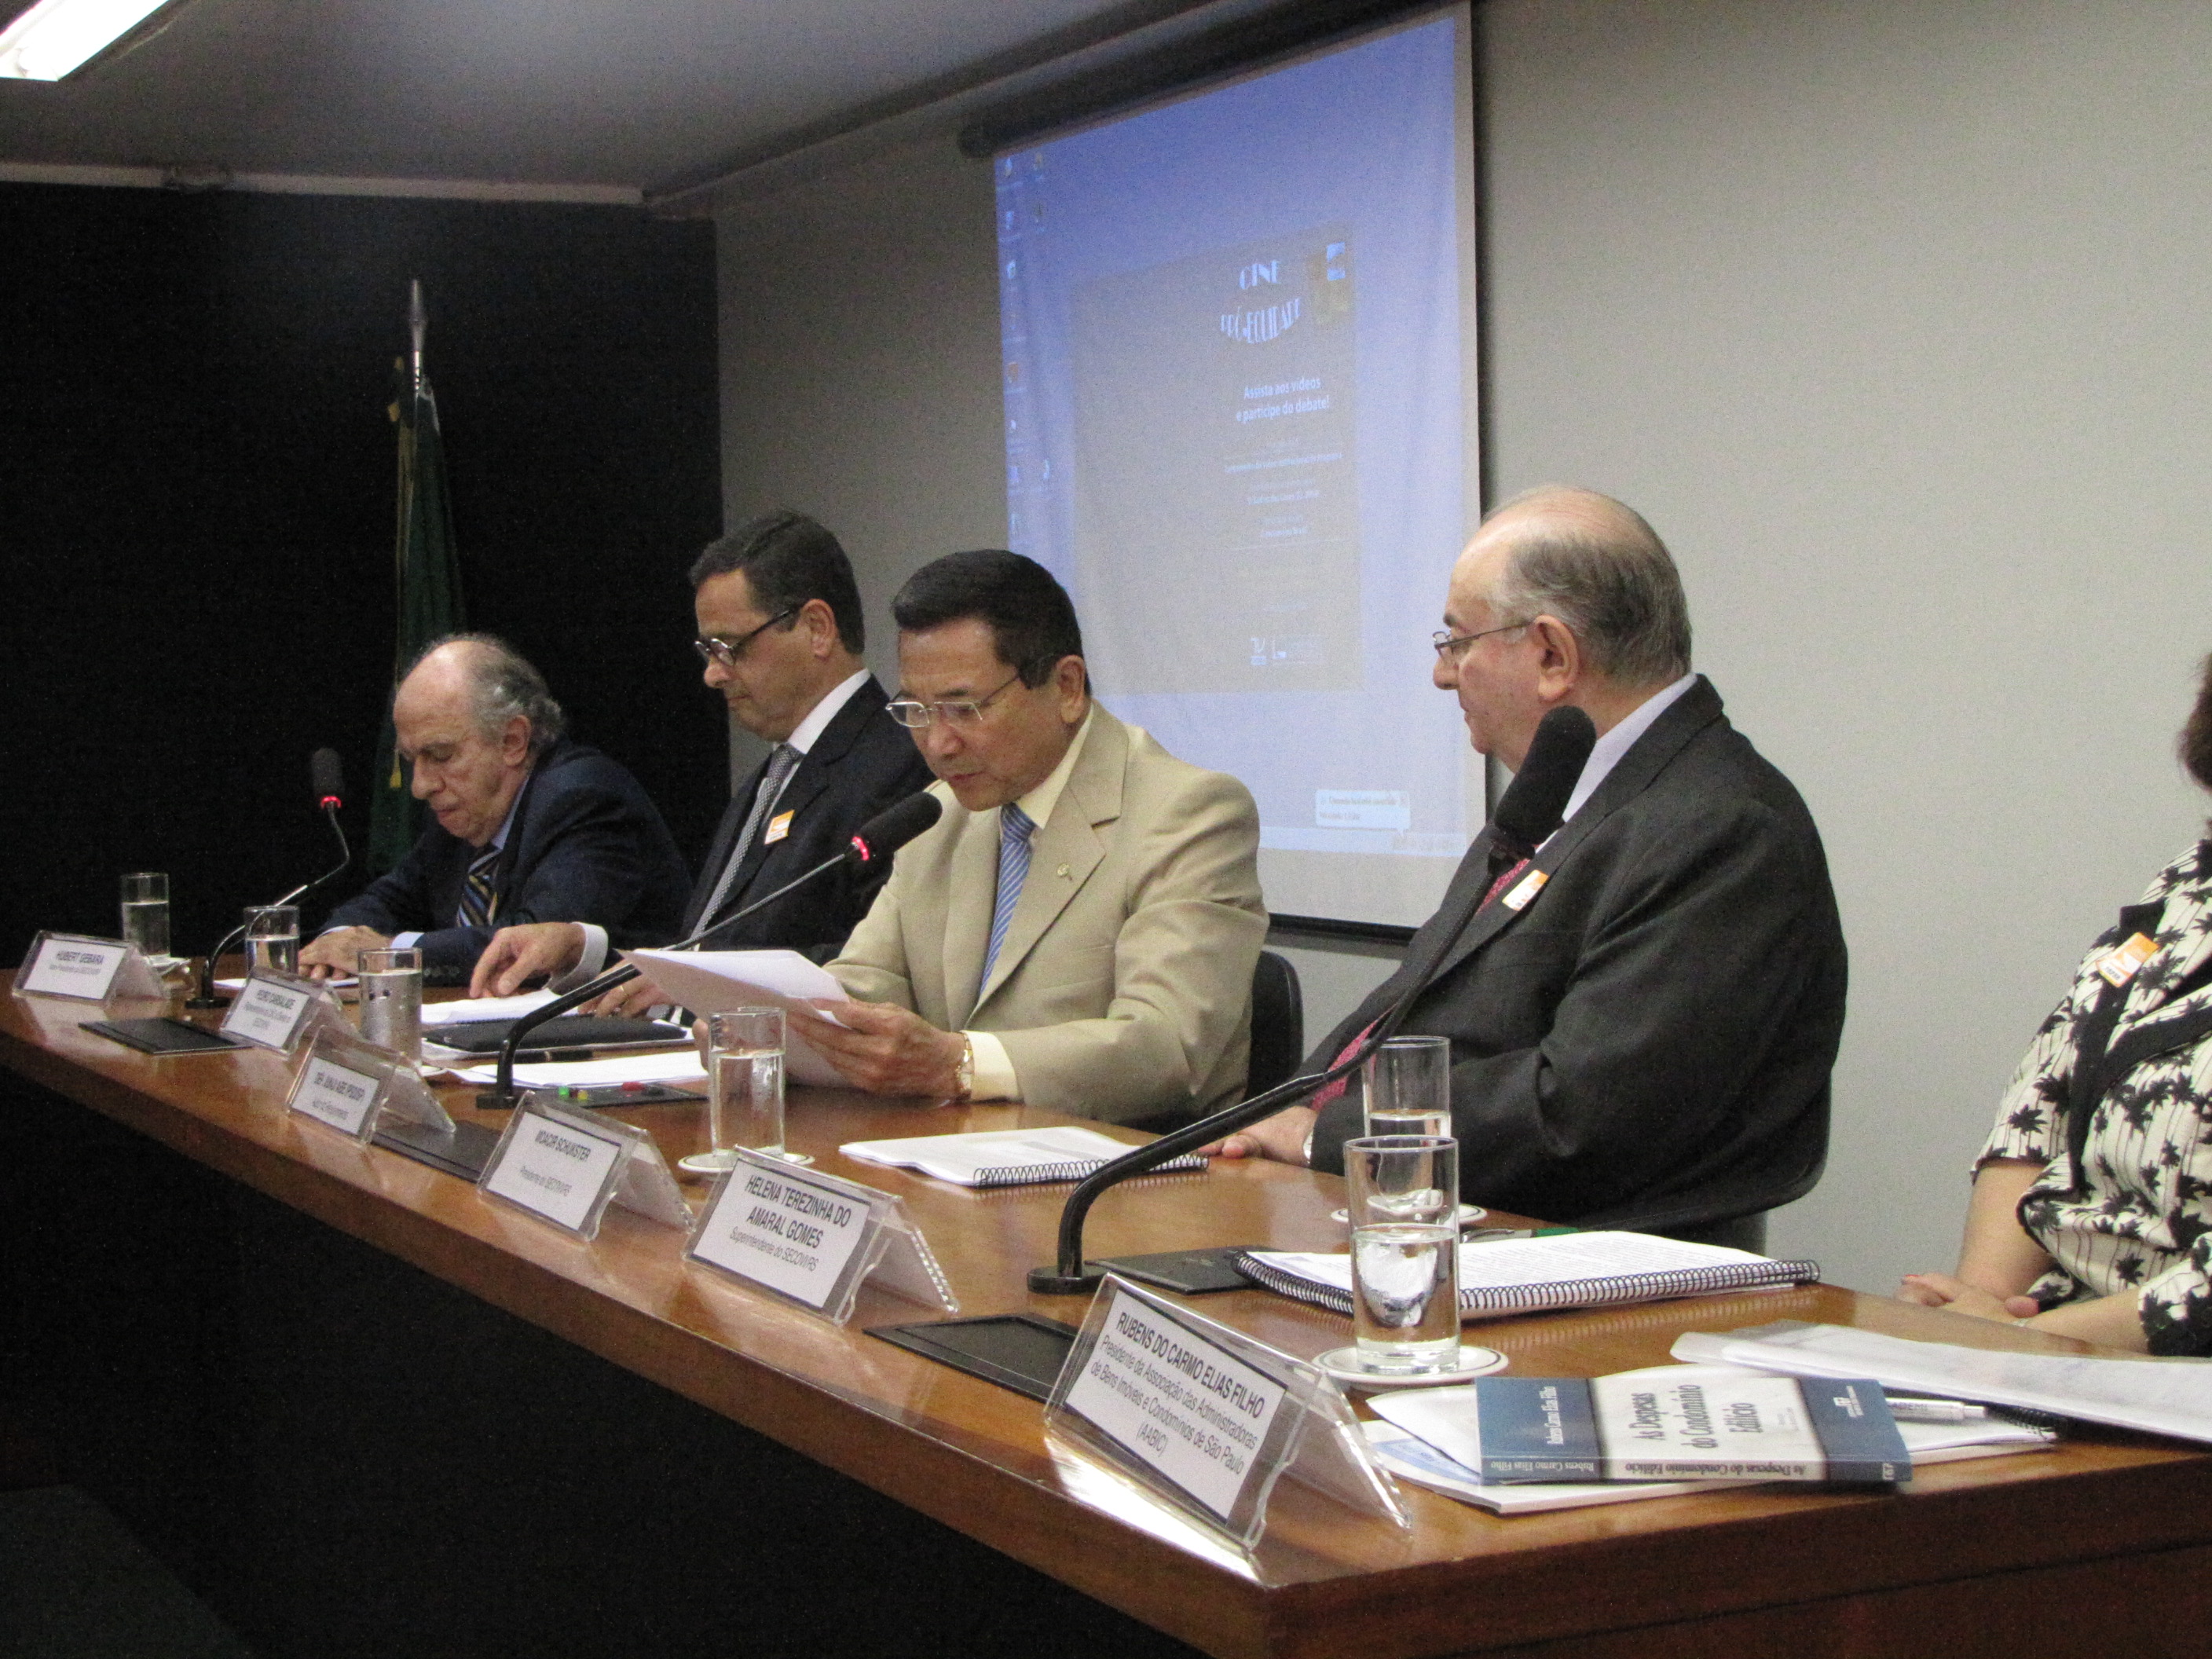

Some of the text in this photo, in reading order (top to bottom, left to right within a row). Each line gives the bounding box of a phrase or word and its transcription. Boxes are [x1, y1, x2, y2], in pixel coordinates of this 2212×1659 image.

[1242, 405, 1281, 424] participe
[1281, 400, 1295, 415] do
[745, 1174, 852, 1228] HELENA TEREZINHA DO
[746, 1206, 824, 1248] AMARAL GOMES
[773, 1243, 783, 1258] do
[1115, 1311, 1265, 1419] RUBENS DO CARMO ELIAS FILHO
[1100, 1335, 1258, 1451] Presidente da Associação das Administradoras
[1090, 1359, 1101, 1377] de
[1100, 1364, 1119, 1389] Bens
[1115, 1375, 1144, 1407] Imóveis
[1148, 1397, 1195, 1441] Condomínios
[1193, 1429, 1206, 1448] de
[1204, 1434, 1222, 1459] São
[1219, 1445, 1245, 1475] Paulo
[1628, 1392, 1670, 1441] As Despesas
[1668, 1384, 1719, 1448] do Condomínio
[1135, 1419, 1169, 1458] (AABIC)
[1491, 1460, 1595, 1471] Rubens Carmo Elias Filho
[1664, 1463, 1727, 1475] Condomínio
[1730, 1463, 1744, 1474] do
[1745, 1462, 1792, 1476] Despesas
[1793, 1464, 1806, 1475] As
